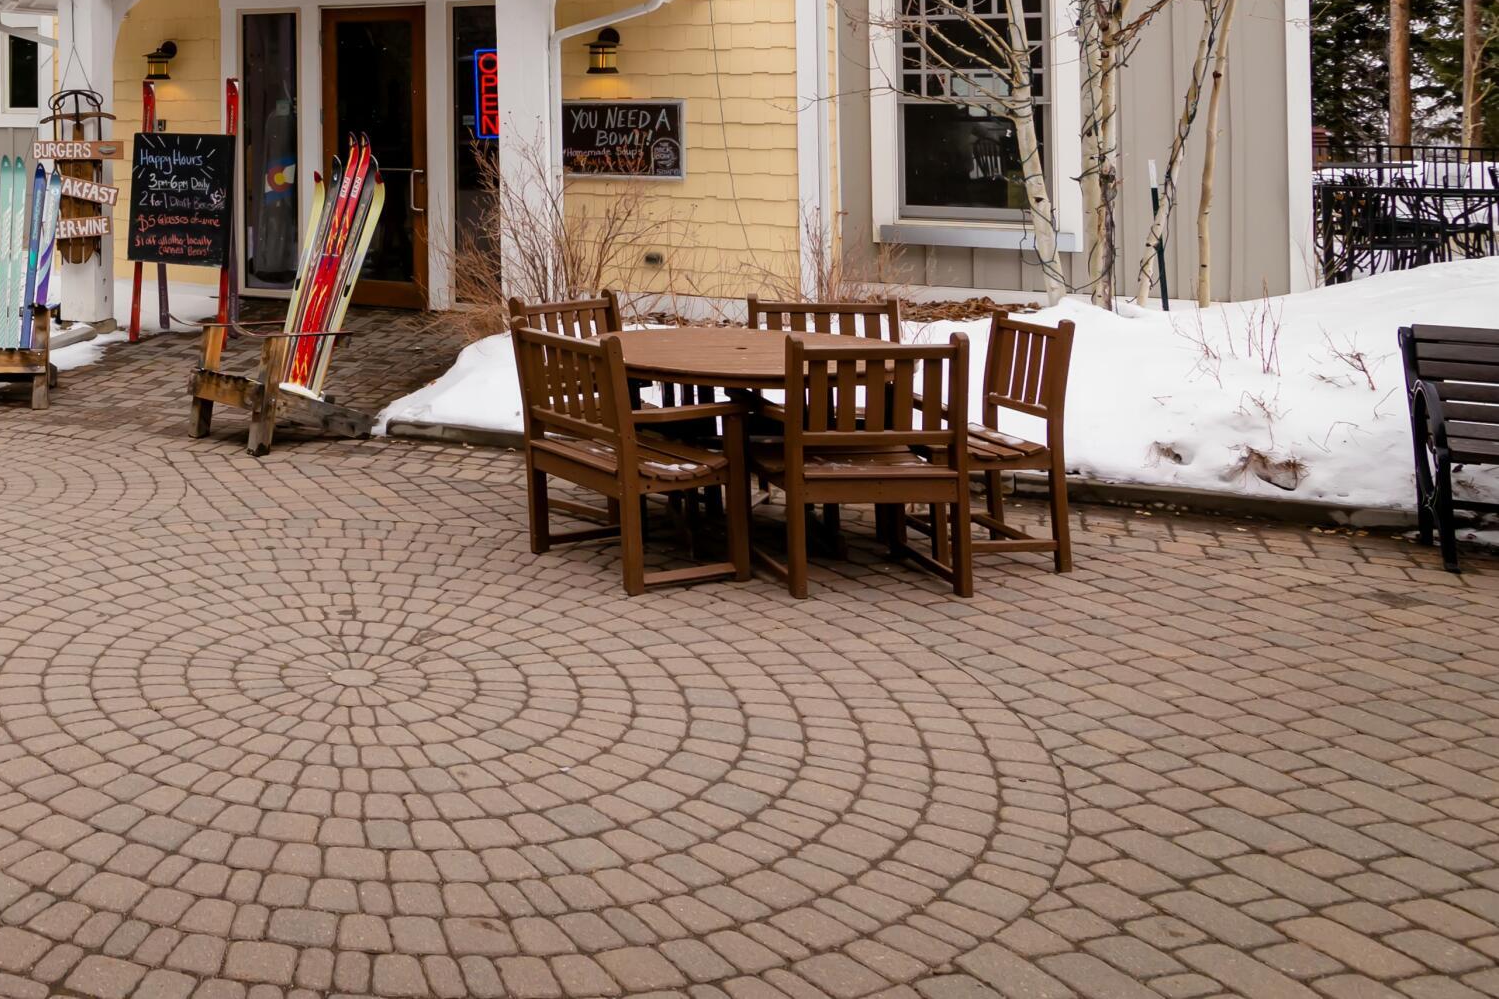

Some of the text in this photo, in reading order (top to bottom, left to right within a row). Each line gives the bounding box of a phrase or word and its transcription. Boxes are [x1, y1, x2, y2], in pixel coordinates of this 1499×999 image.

[479, 53, 499, 135] OPEN
[570, 106, 671, 133] YOU NEED A
[33, 142, 92, 159] BURGERS
[140, 148, 203, 175] Happy Hours
[61, 178, 118, 205] AKFAST
[139, 190, 149, 206] 2
[150, 193, 162, 206] for
[191, 177, 210, 195] Daily
